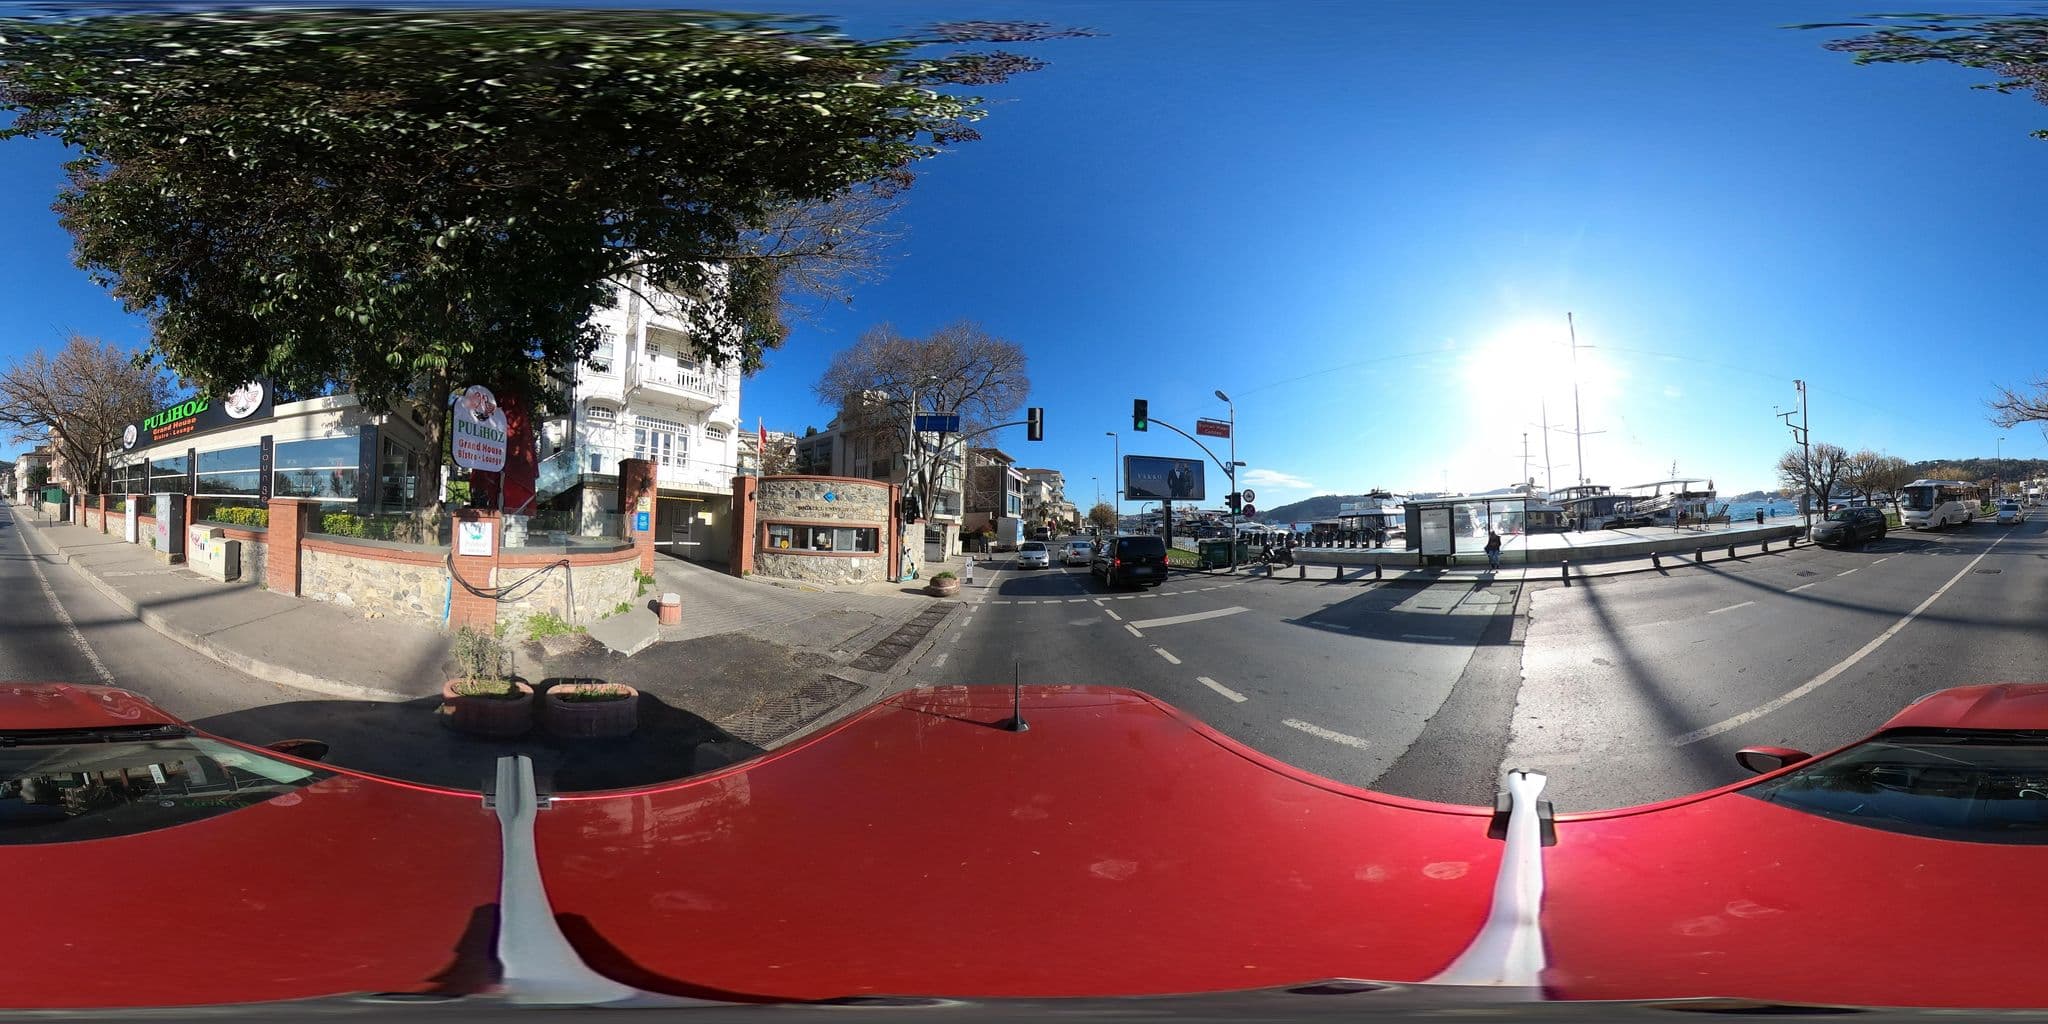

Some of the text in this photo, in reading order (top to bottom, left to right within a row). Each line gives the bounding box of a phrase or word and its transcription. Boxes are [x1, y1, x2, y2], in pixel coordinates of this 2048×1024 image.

[153, 424, 172, 435] Grand
[459, 438, 502, 455] Grand House
[458, 449, 502, 466] Bistro Lounge
